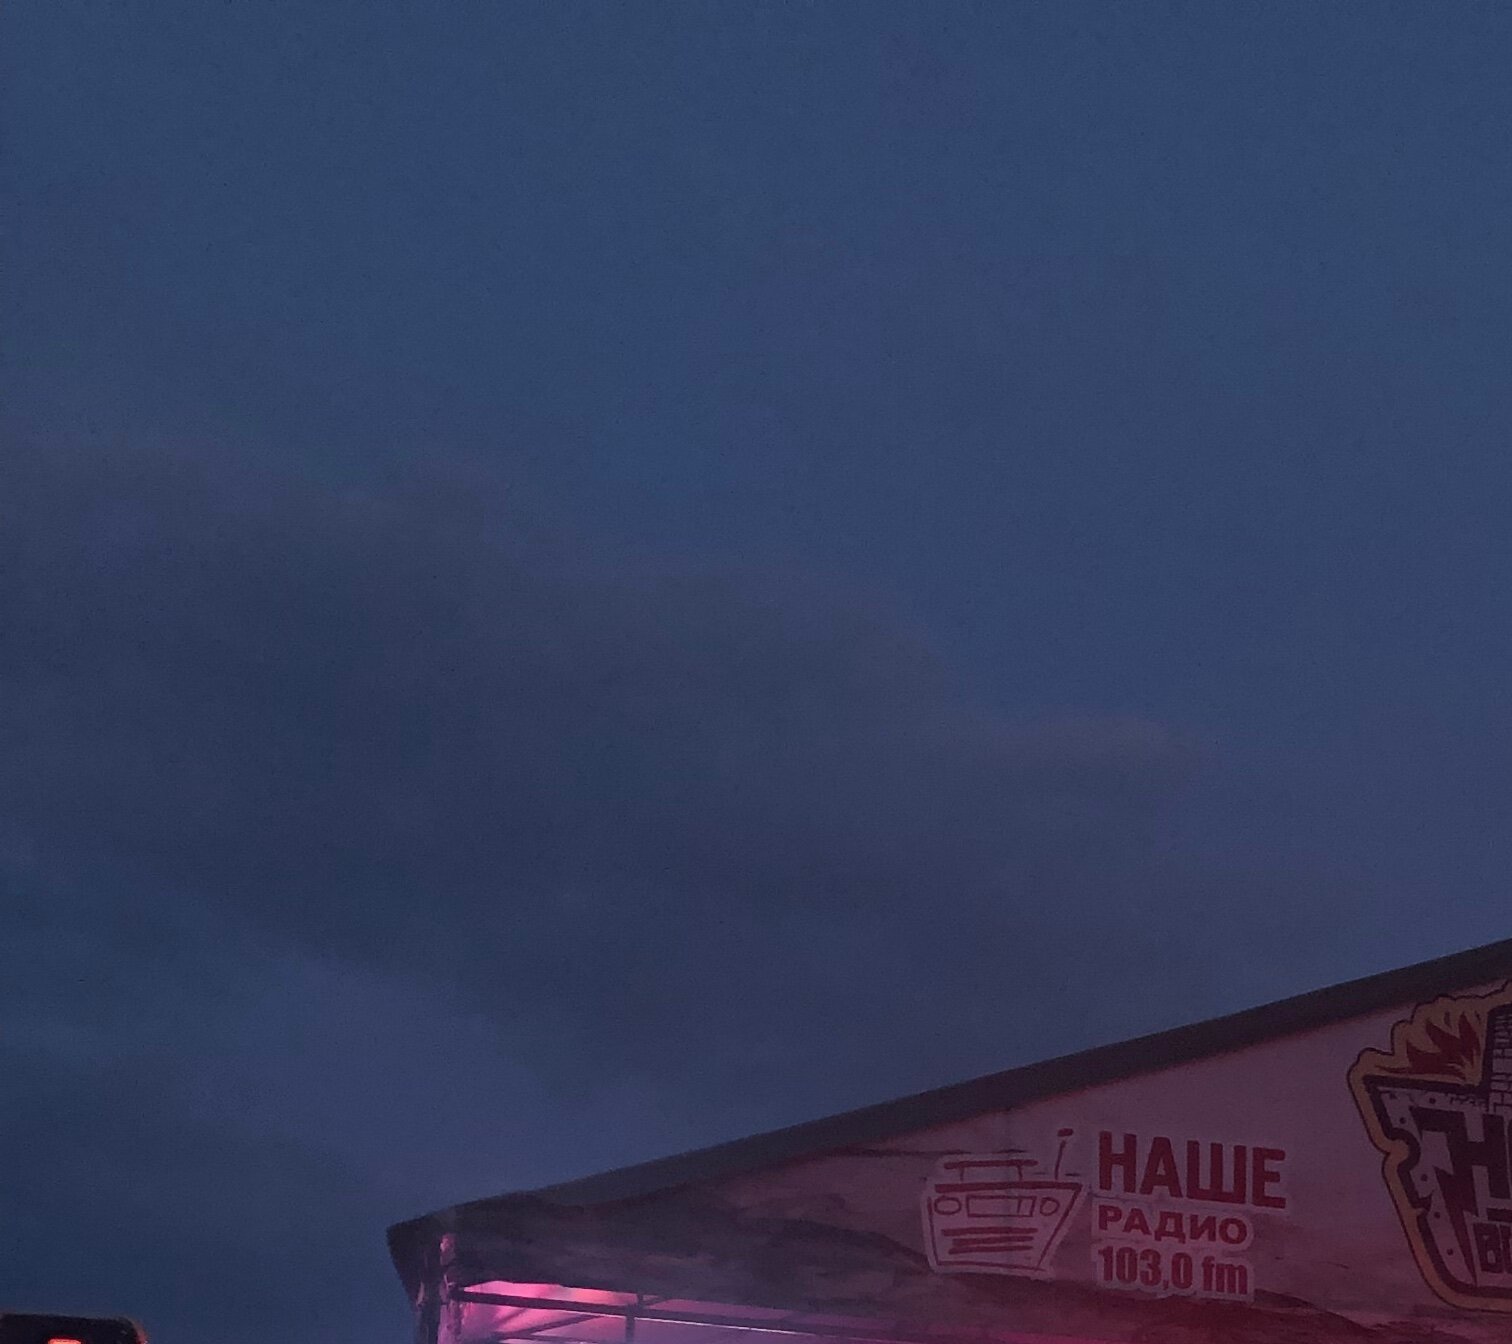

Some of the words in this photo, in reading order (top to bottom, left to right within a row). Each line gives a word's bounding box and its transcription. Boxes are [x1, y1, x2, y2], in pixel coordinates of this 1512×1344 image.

[1098, 1130, 1287, 1209] НАШЕ
[1098, 1204, 1248, 1245] РАДИО
[1098, 1246, 1194, 1291] 103,0
[1201, 1255, 1249, 1295] fm
